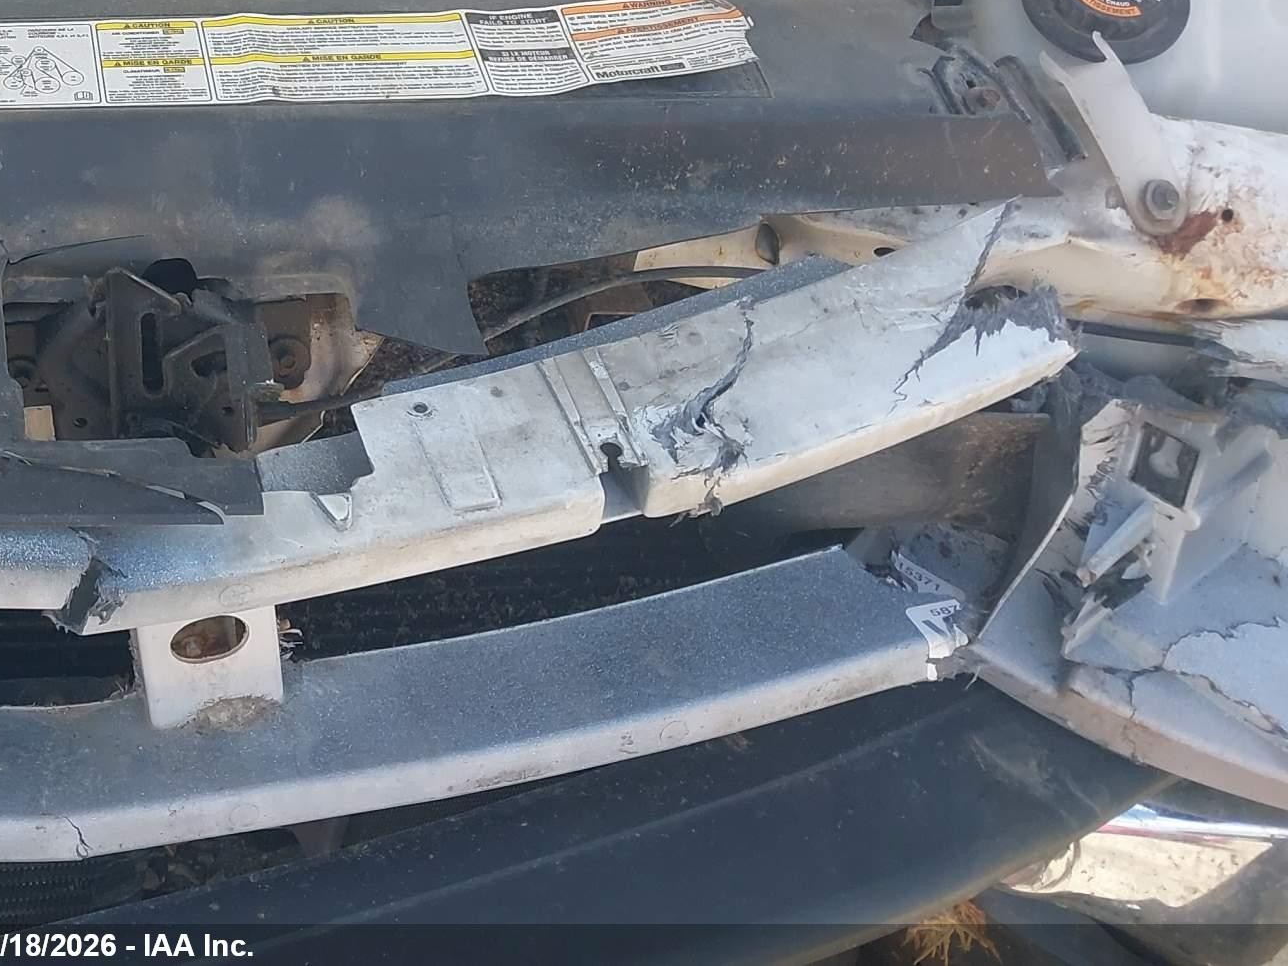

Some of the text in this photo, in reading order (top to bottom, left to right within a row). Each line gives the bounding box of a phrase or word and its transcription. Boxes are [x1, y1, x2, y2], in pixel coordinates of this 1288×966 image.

[630, 0, 672, 9] WARNING
[519, 17, 546, 25] START
[595, 65, 661, 79] Motorcraft
